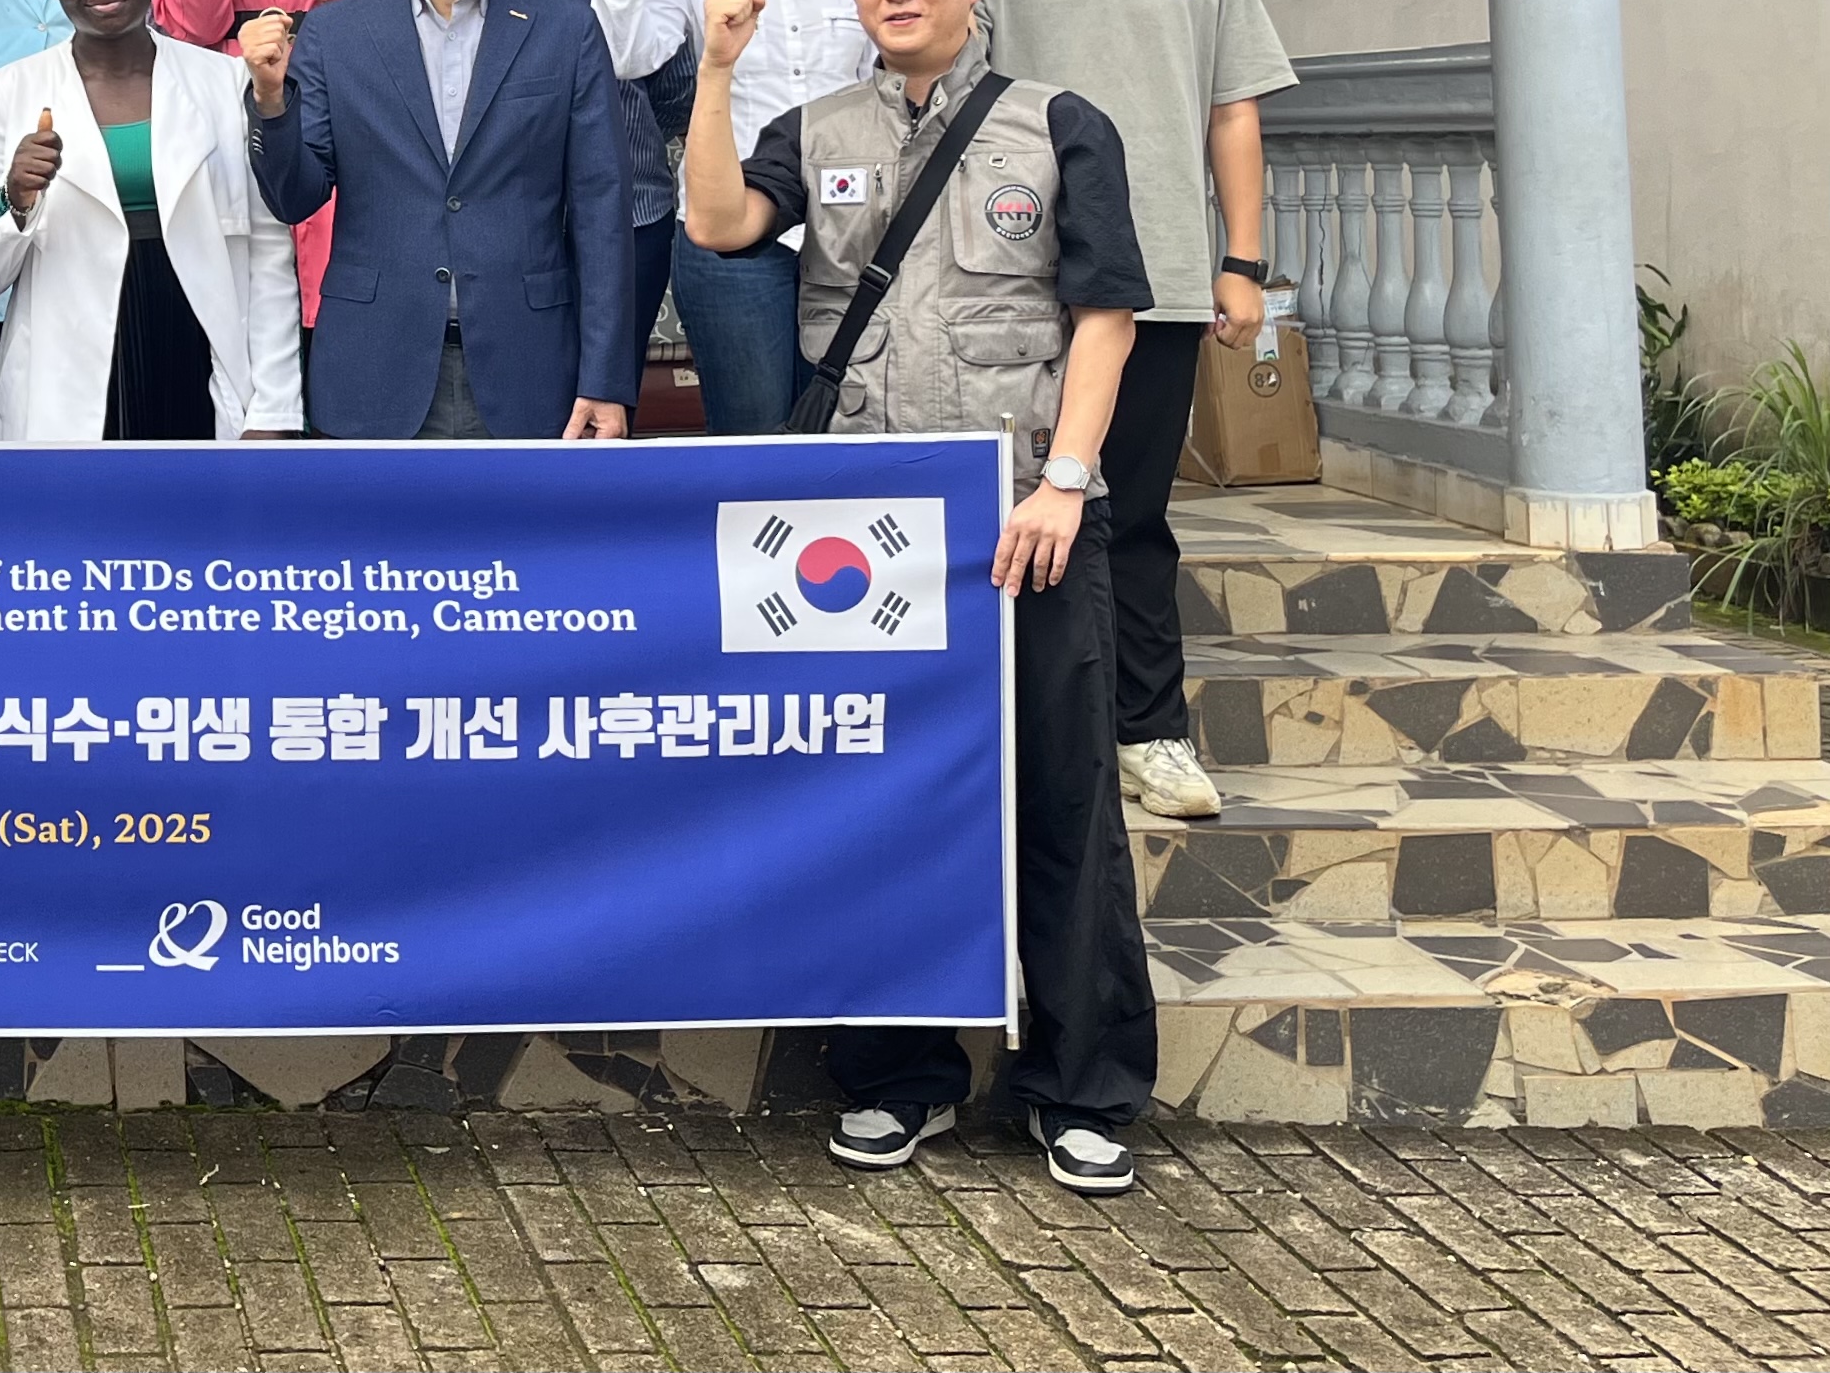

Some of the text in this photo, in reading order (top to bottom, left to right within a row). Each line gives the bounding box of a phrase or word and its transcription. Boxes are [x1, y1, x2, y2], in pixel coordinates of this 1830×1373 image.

[9, 559, 72, 592] the
[81, 559, 194, 592] NTDs
[204, 559, 355, 592] Control
[362, 559, 520, 600] through
[77, 600, 118, 632] in
[128, 599, 261, 632] Centre
[270, 599, 420, 640] Region,
[432, 599, 638, 632] Cameroon
[268, 693, 389, 762] 통합
[405, 696, 518, 760] 개선
[538, 692, 886, 760] 사후관리사업
[114, 813, 211, 844] 2025
[241, 903, 321, 930] Good
[241, 936, 400, 972] Neighbors
